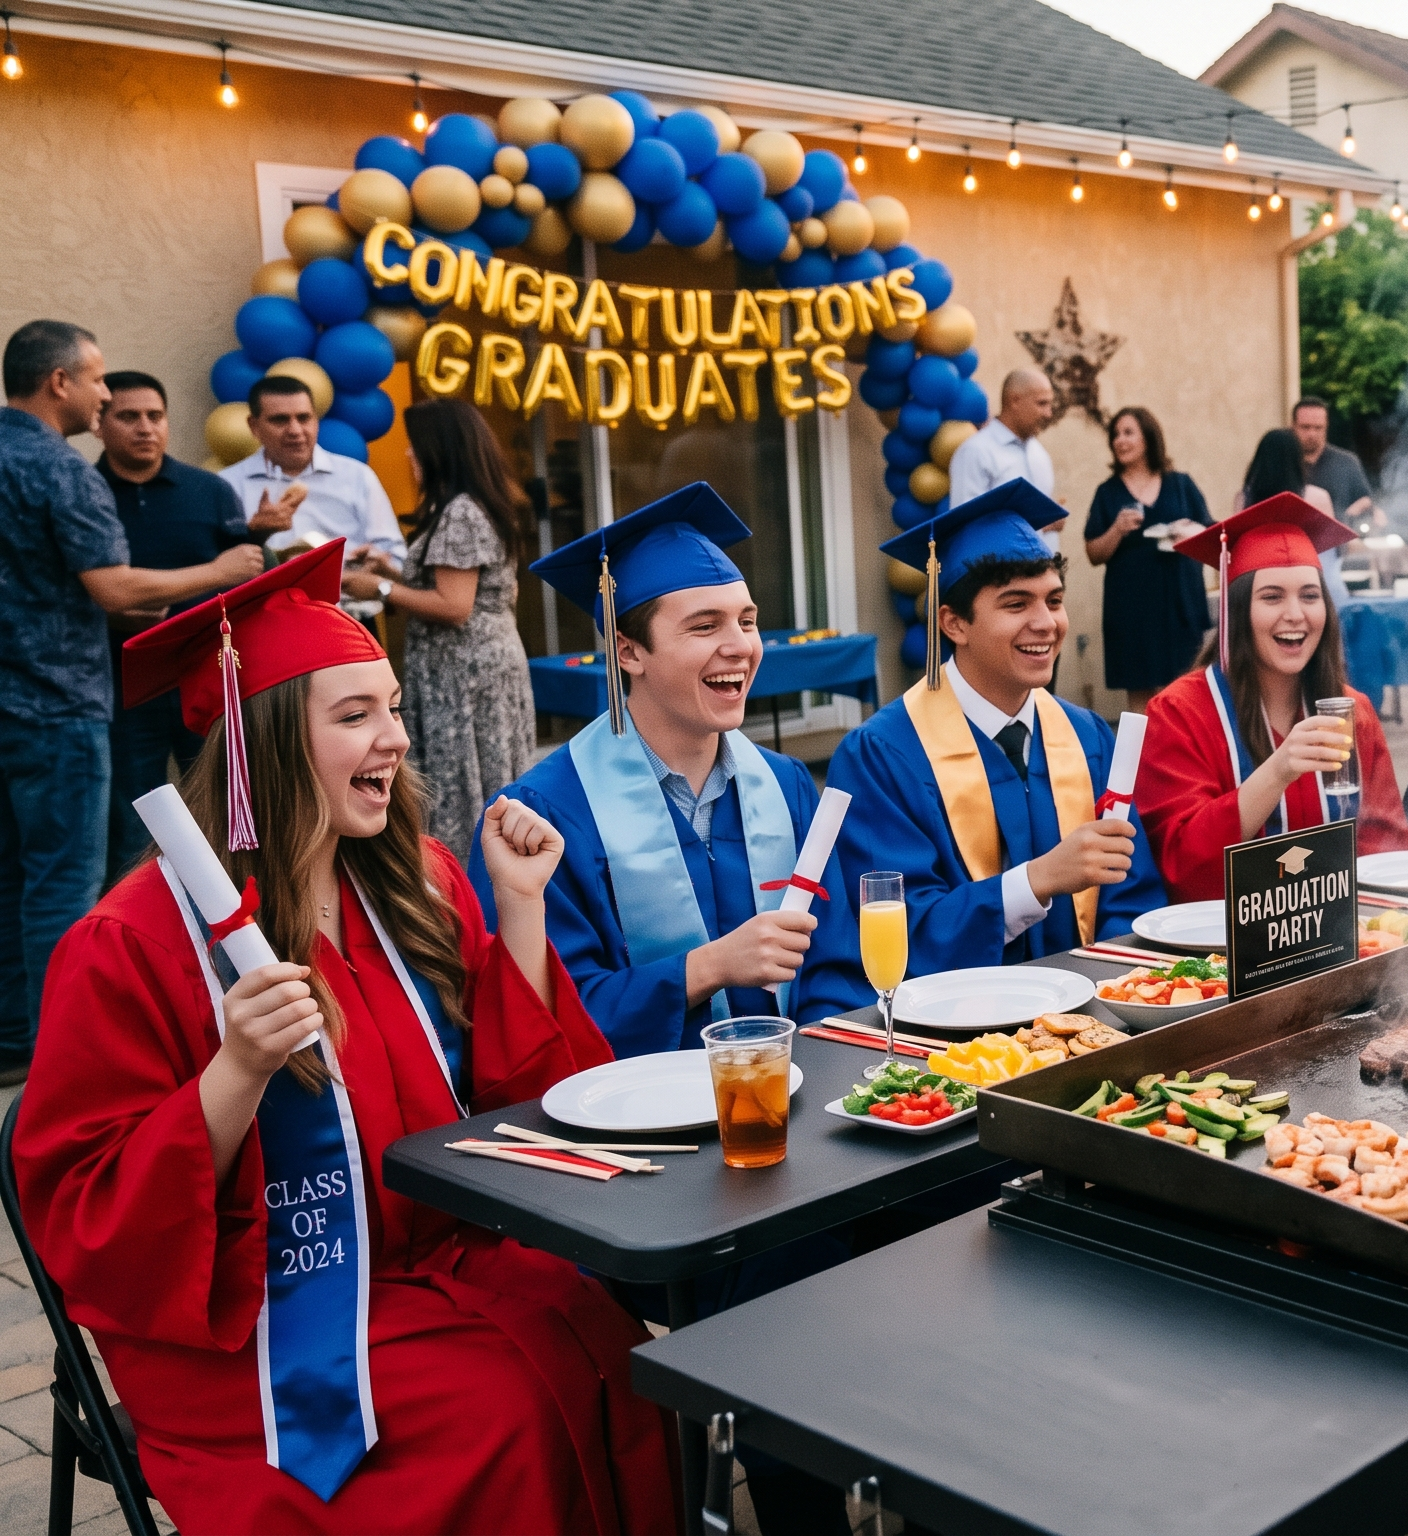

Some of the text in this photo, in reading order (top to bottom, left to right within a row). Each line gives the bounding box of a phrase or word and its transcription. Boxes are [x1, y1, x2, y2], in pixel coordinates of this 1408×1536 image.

[363, 220, 927, 349] CONGRATULATIONS
[416, 322, 852, 428] GRADUATES
[1238, 869, 1350, 926] GRADUATION
[1268, 908, 1324, 952] PARTY
[264, 1170, 347, 1209] CLASS
[291, 1207, 327, 1238] OF
[281, 1237, 345, 1276] 2024
